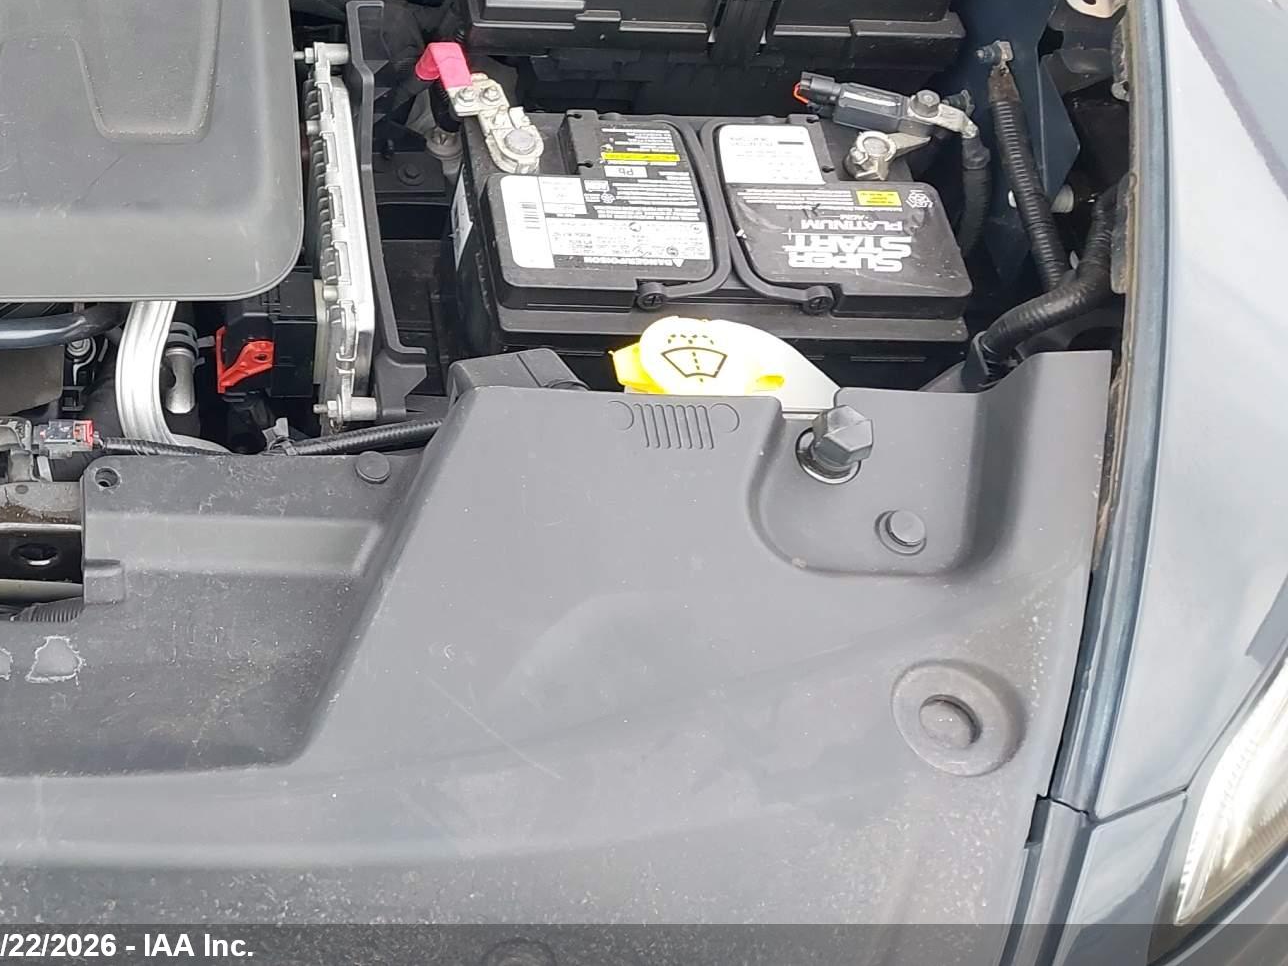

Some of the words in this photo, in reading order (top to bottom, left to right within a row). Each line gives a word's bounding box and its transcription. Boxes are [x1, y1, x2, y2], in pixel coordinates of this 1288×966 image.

[801, 220, 903, 231] PLATINUM
[786, 235, 912, 258] START
[788, 251, 903, 273] SUPER
